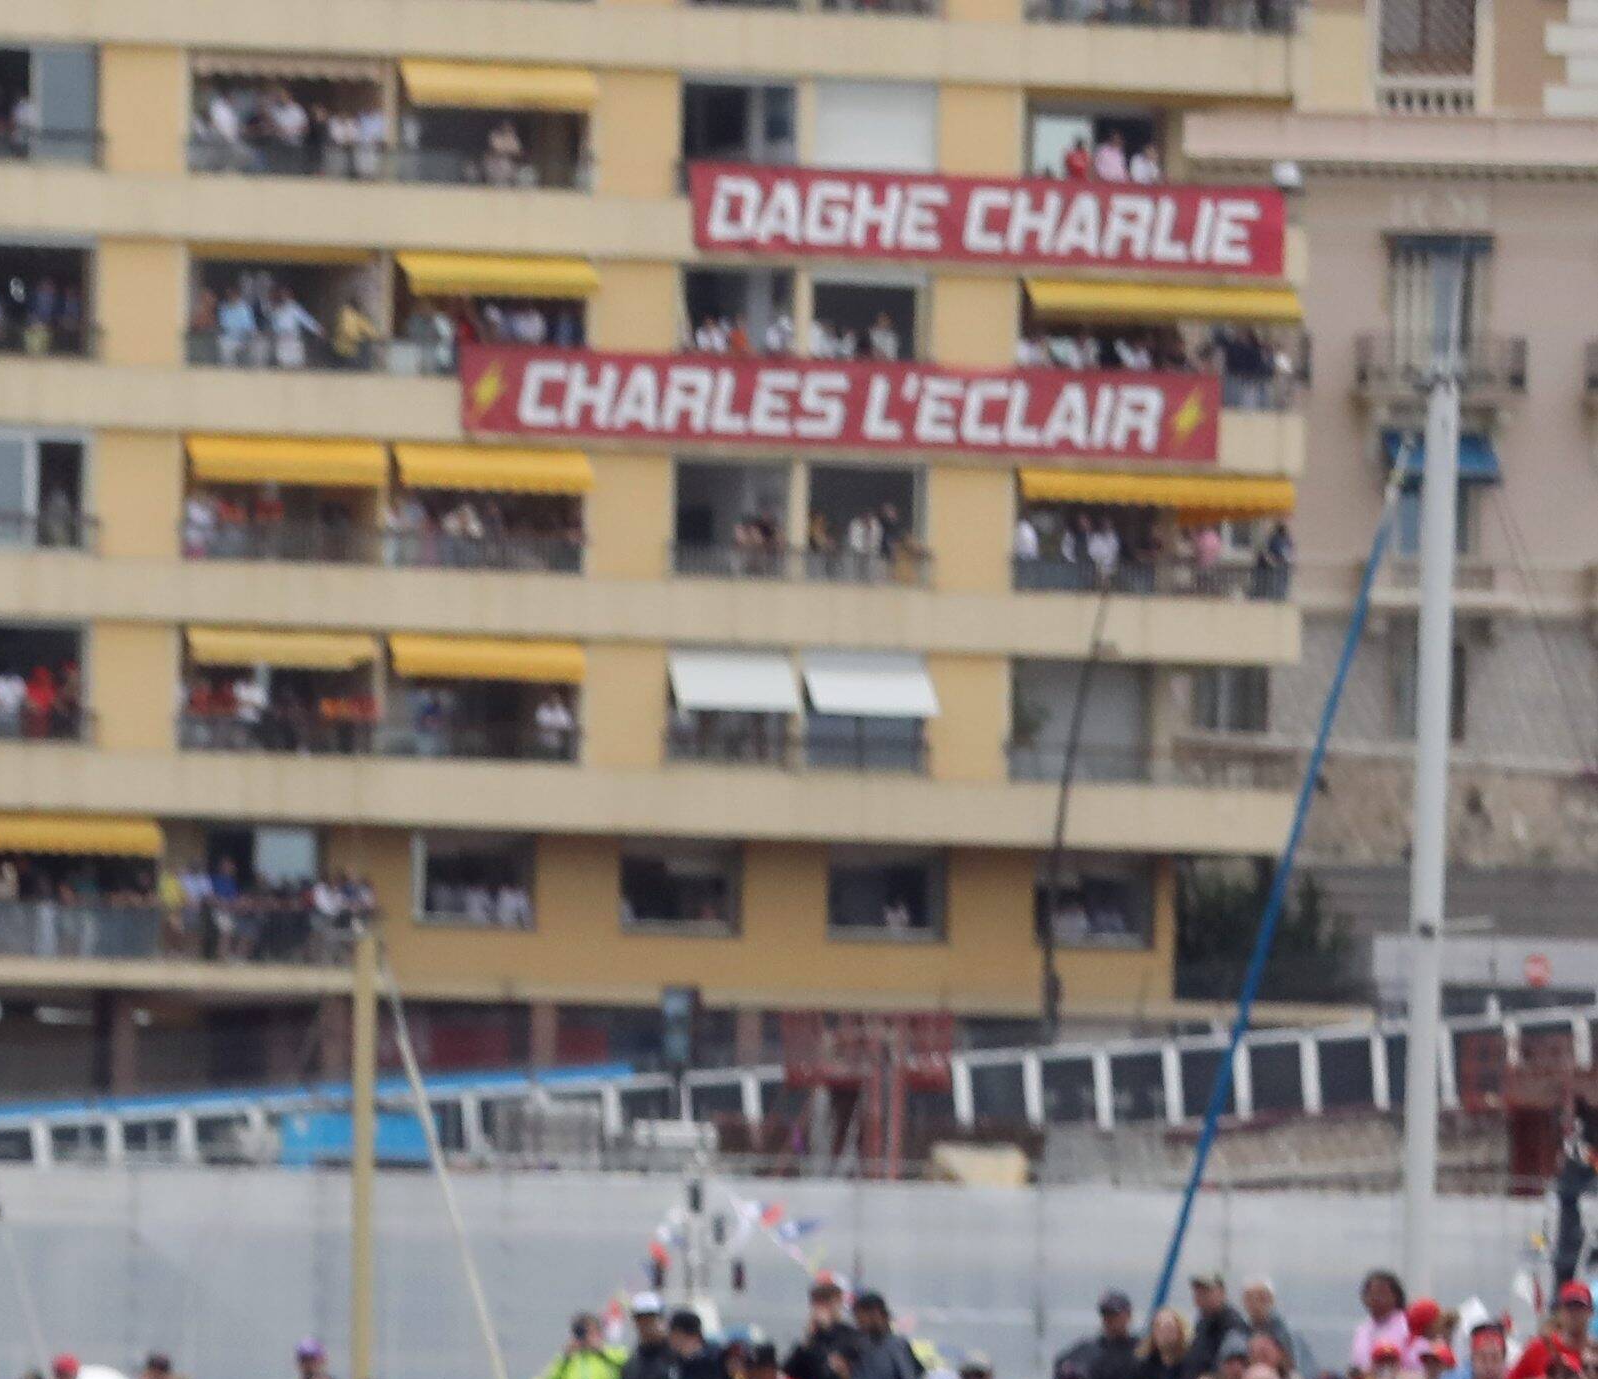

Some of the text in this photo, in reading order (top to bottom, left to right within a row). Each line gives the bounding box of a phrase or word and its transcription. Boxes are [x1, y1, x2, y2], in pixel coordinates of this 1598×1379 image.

[707, 175, 1262, 265] DAGHE CHARLIE
[516, 359, 1166, 452] CHARLES L'ECLAIR
